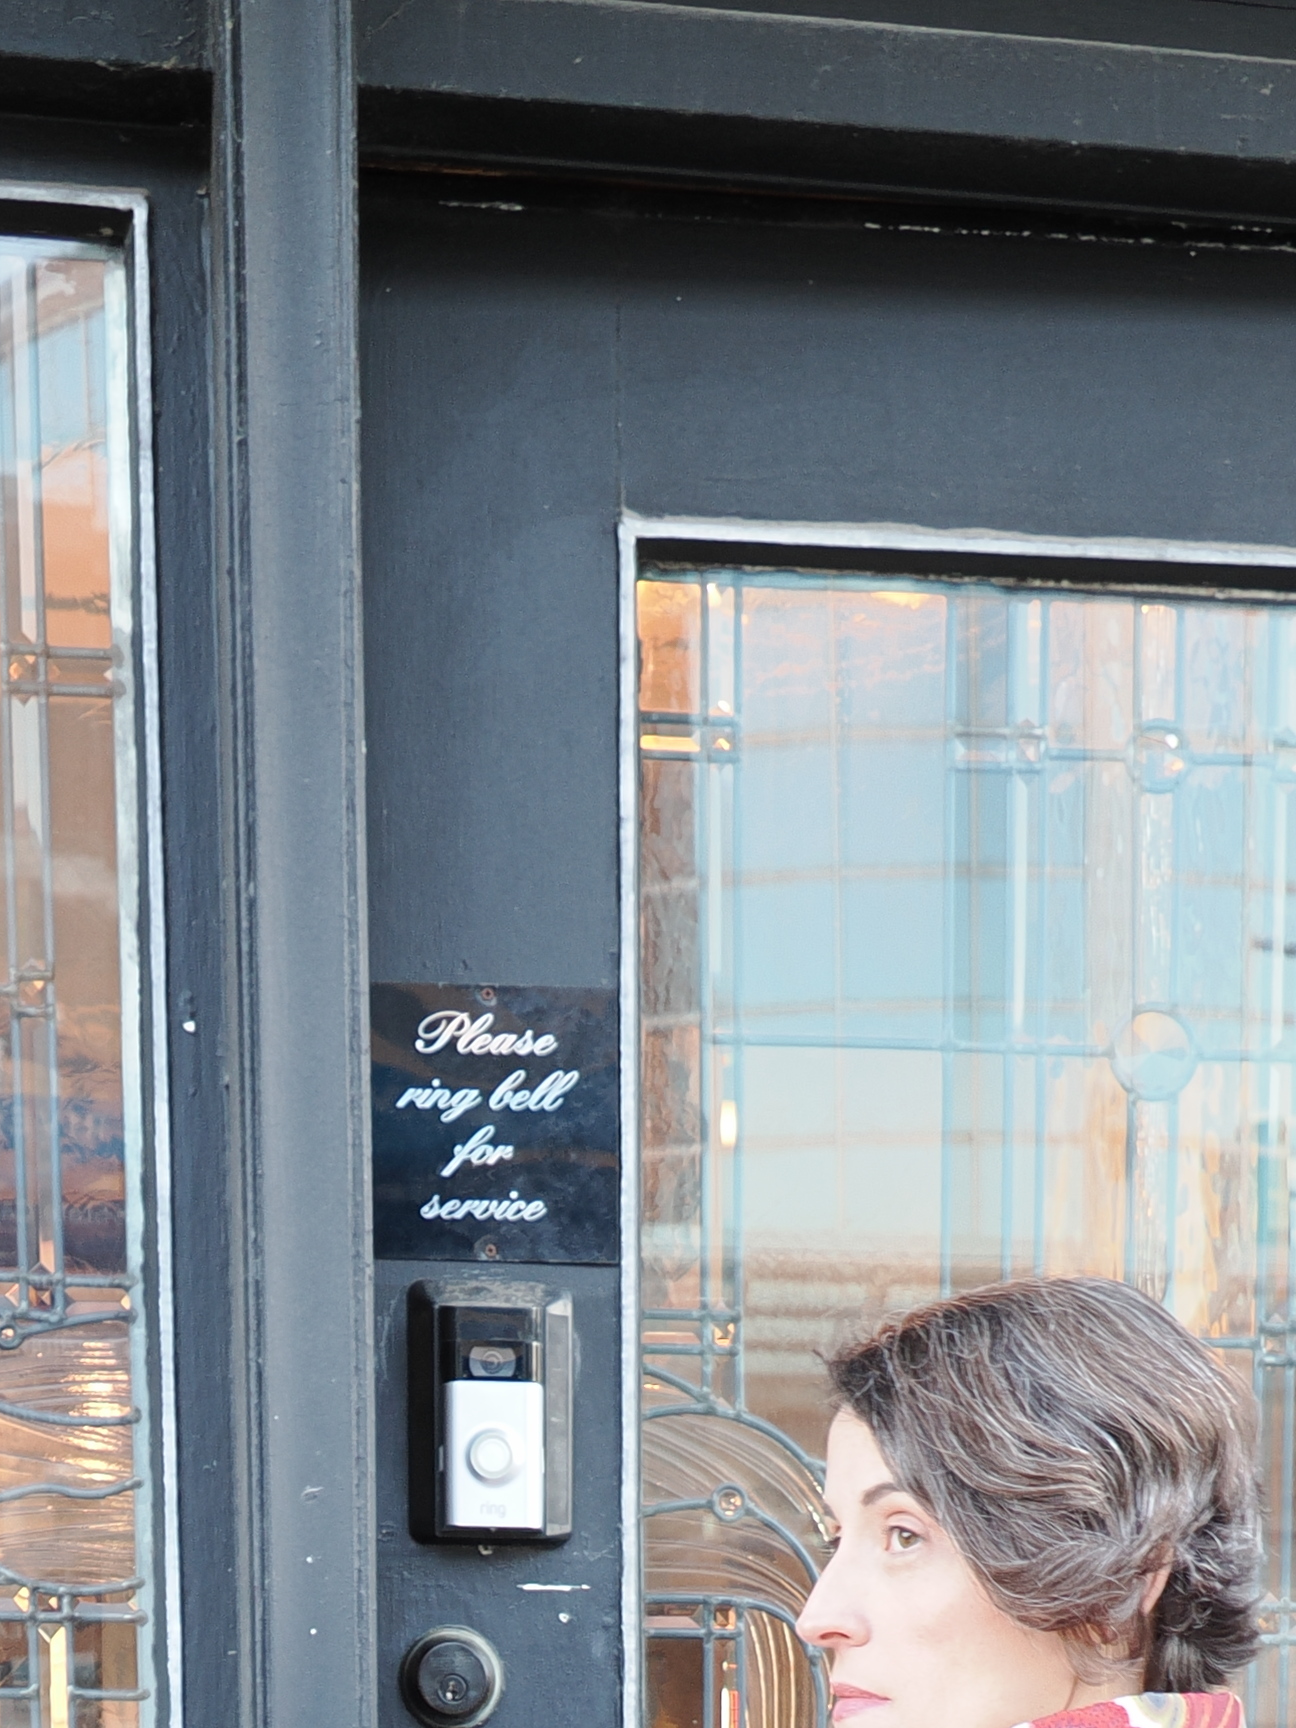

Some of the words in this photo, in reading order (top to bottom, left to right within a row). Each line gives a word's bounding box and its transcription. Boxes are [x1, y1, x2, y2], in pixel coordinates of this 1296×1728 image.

[415, 1010, 558, 1056] Please
[395, 1077, 482, 1123] ring
[488, 1069, 580, 1112] bell
[440, 1124, 514, 1178] for
[419, 1190, 547, 1221] service
[479, 1500, 507, 1519] ring
